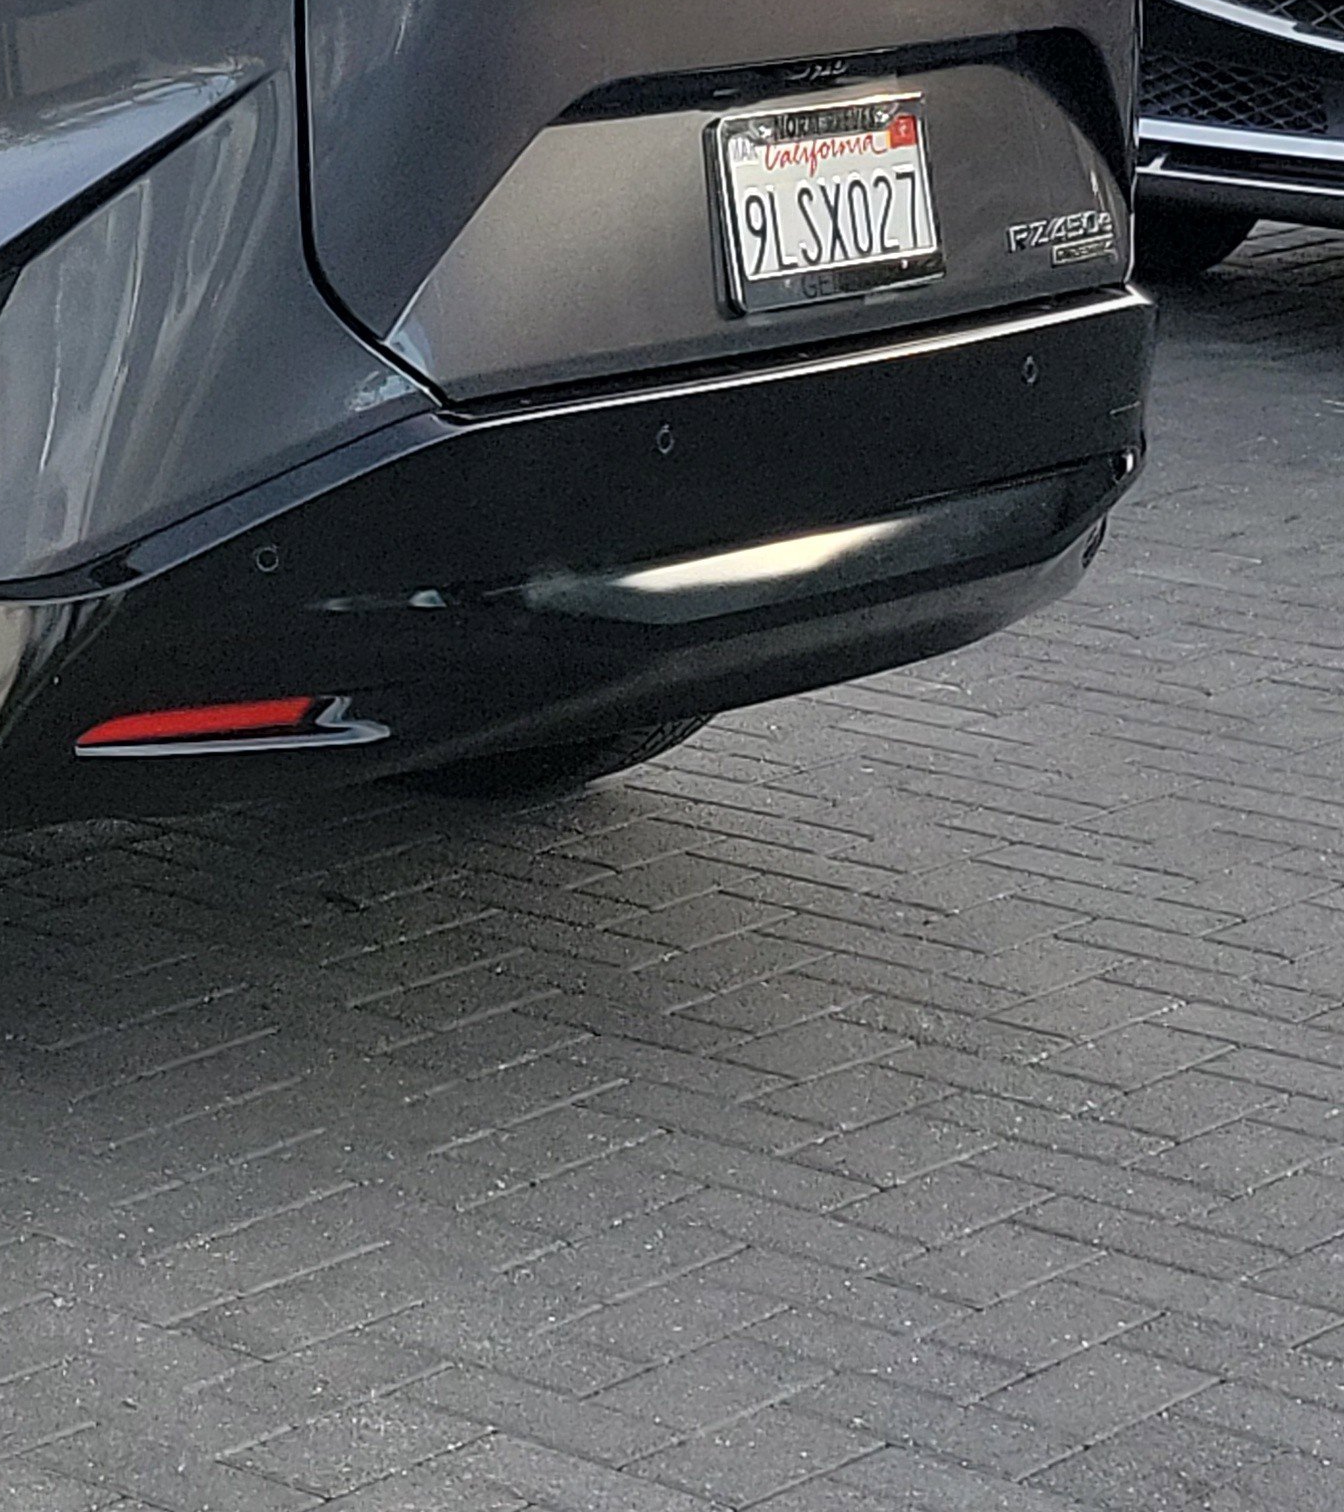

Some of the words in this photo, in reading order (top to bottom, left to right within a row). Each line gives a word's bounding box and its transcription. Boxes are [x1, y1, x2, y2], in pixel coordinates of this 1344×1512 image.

[765, 133, 888, 178] California
[745, 170, 920, 276] 9LSX027
[1007, 210, 1112, 253] RZ450e
